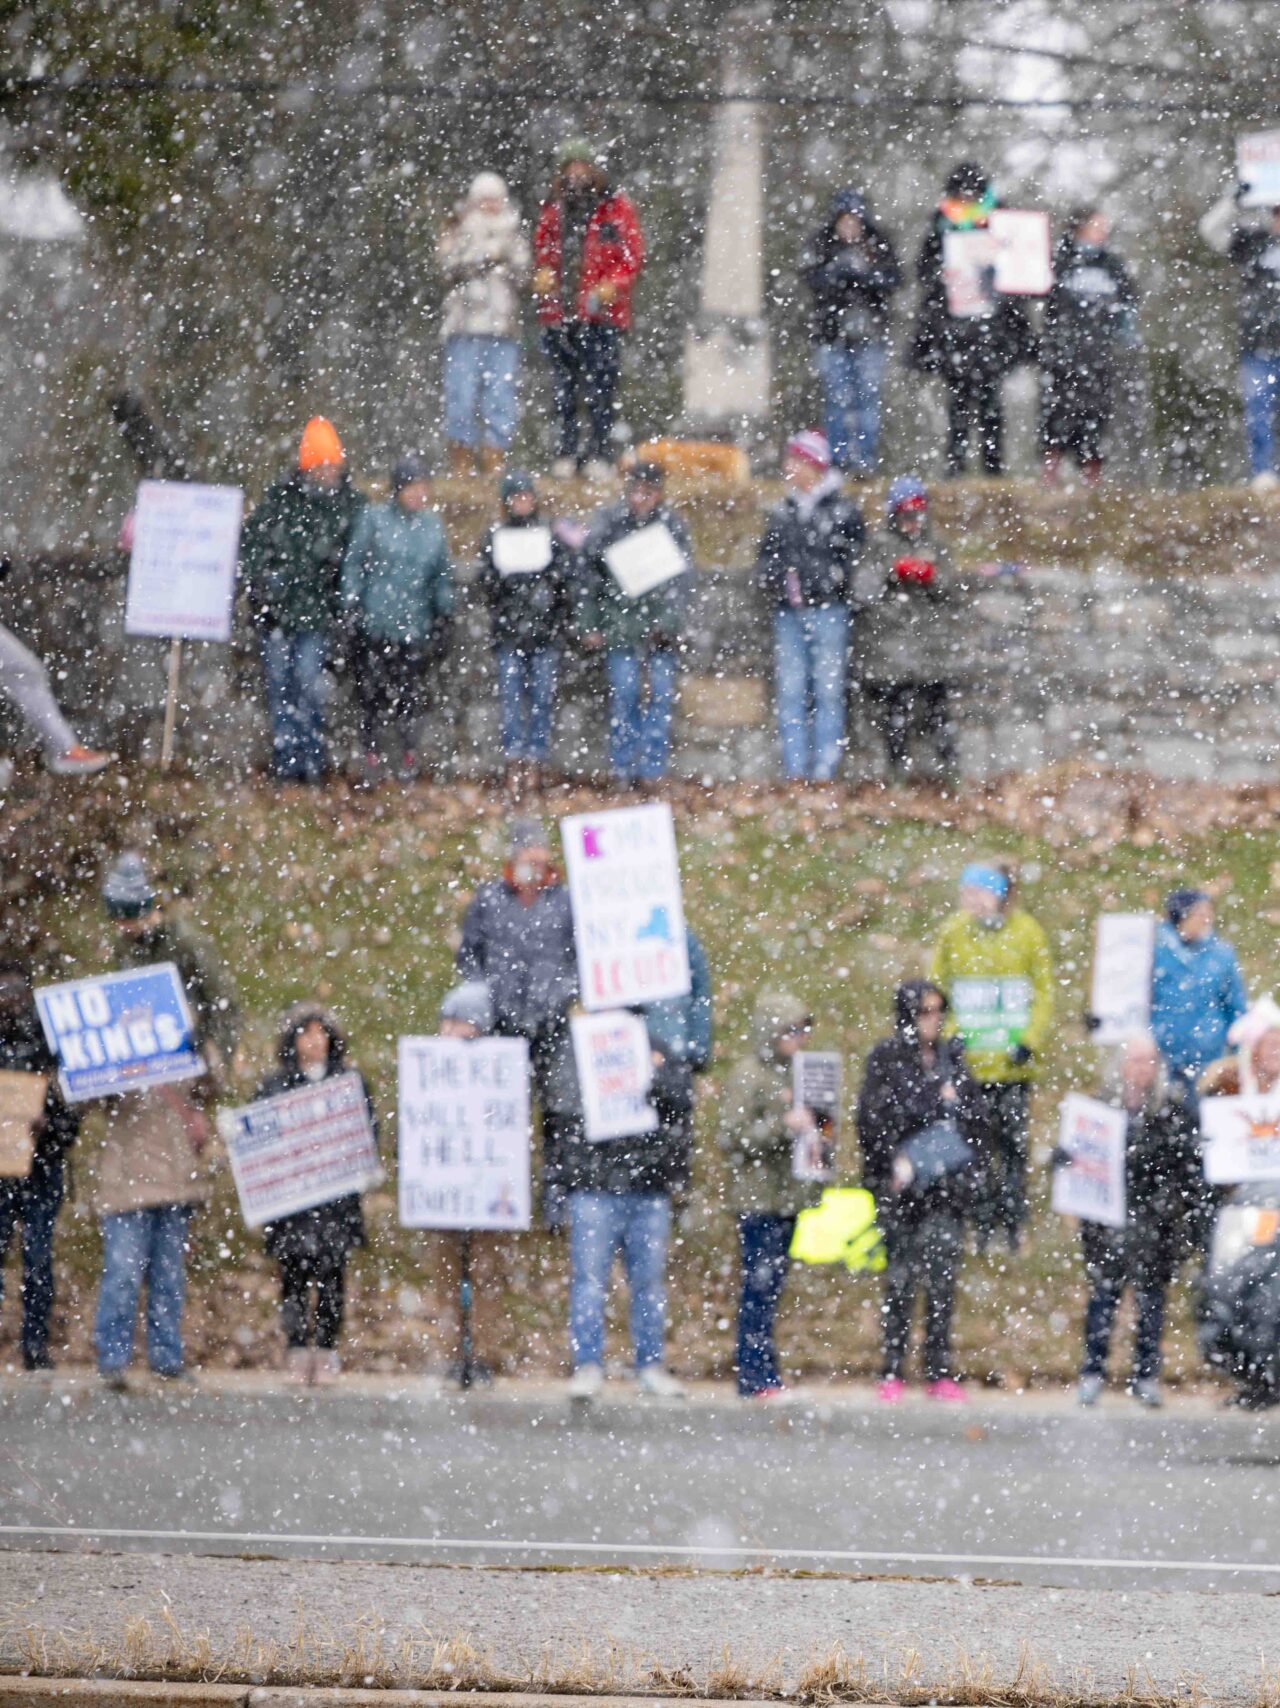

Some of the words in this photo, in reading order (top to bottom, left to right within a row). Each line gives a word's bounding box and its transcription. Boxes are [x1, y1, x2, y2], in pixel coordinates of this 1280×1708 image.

[47, 986, 112, 1034] NO
[58, 1013, 184, 1071] KINGS
[420, 1135, 509, 1167] HELL
